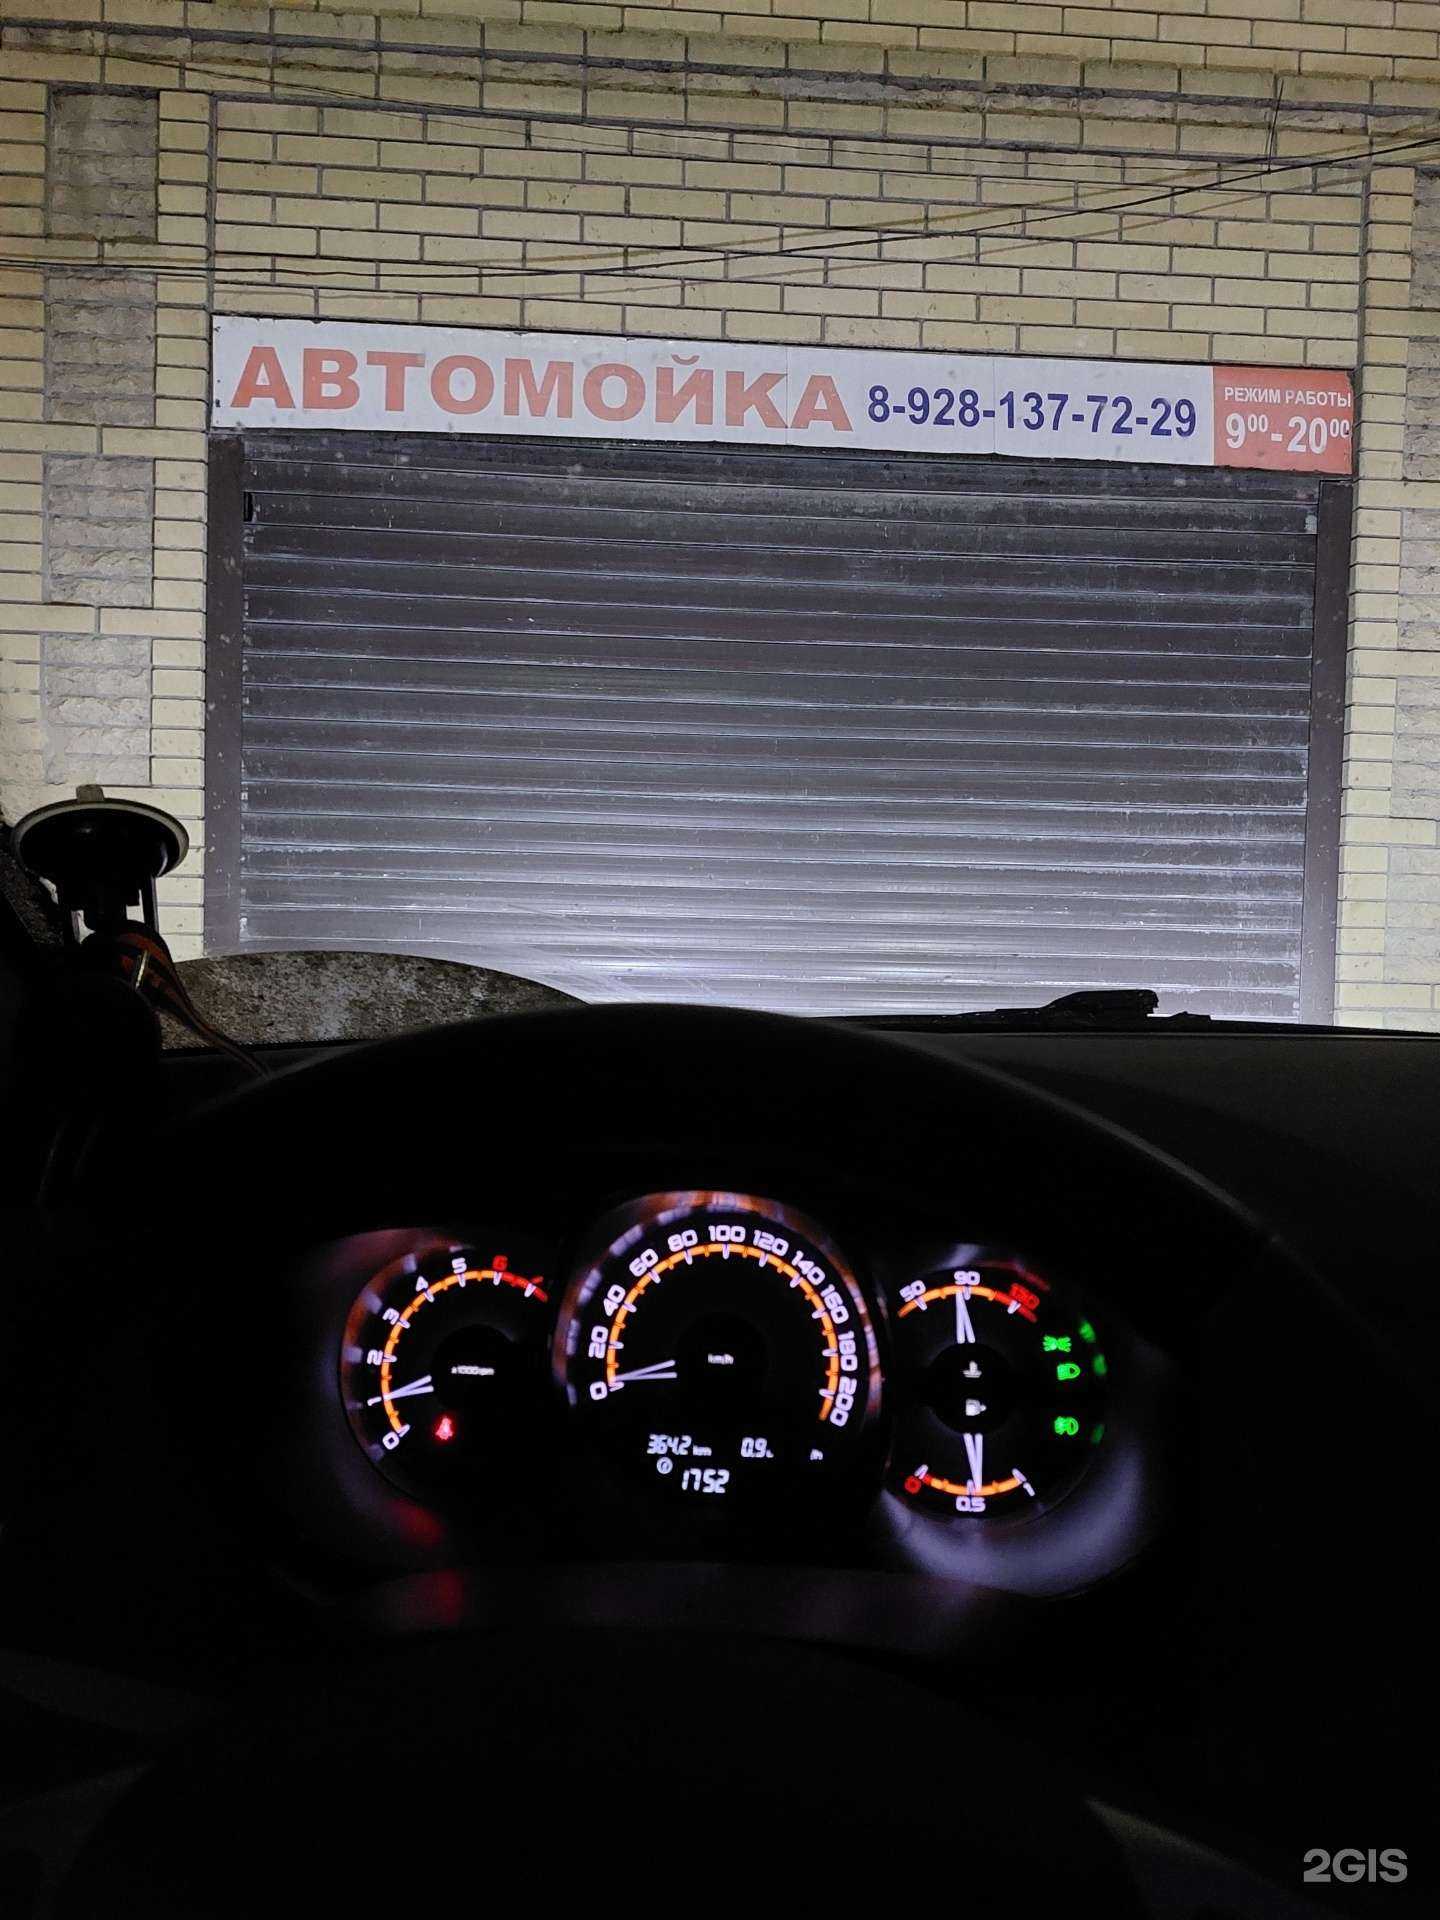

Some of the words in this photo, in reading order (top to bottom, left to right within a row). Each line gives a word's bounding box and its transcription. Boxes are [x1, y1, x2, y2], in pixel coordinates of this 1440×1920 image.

[230, 345, 854, 431] АВТОМОЙКА
[1224, 386, 1281, 404] РЕЖИМ
[1285, 390, 1352, 408] РАБОТЫ
[867, 384, 1197, 438] 8-928-137-72-29
[708, 1225, 746, 1243] 100
[752, 1229, 790, 1257] 120
[628, 1248, 660, 1277] 60
[791, 1250, 826, 1286] 140
[603, 1284, 626, 1316] 40
[820, 1284, 849, 1325] 160
[588, 1325, 609, 1359] 20
[589, 1381, 608, 1401] 0
[829, 1376, 858, 1427] 200
[382, 1431, 400, 1450] 0
